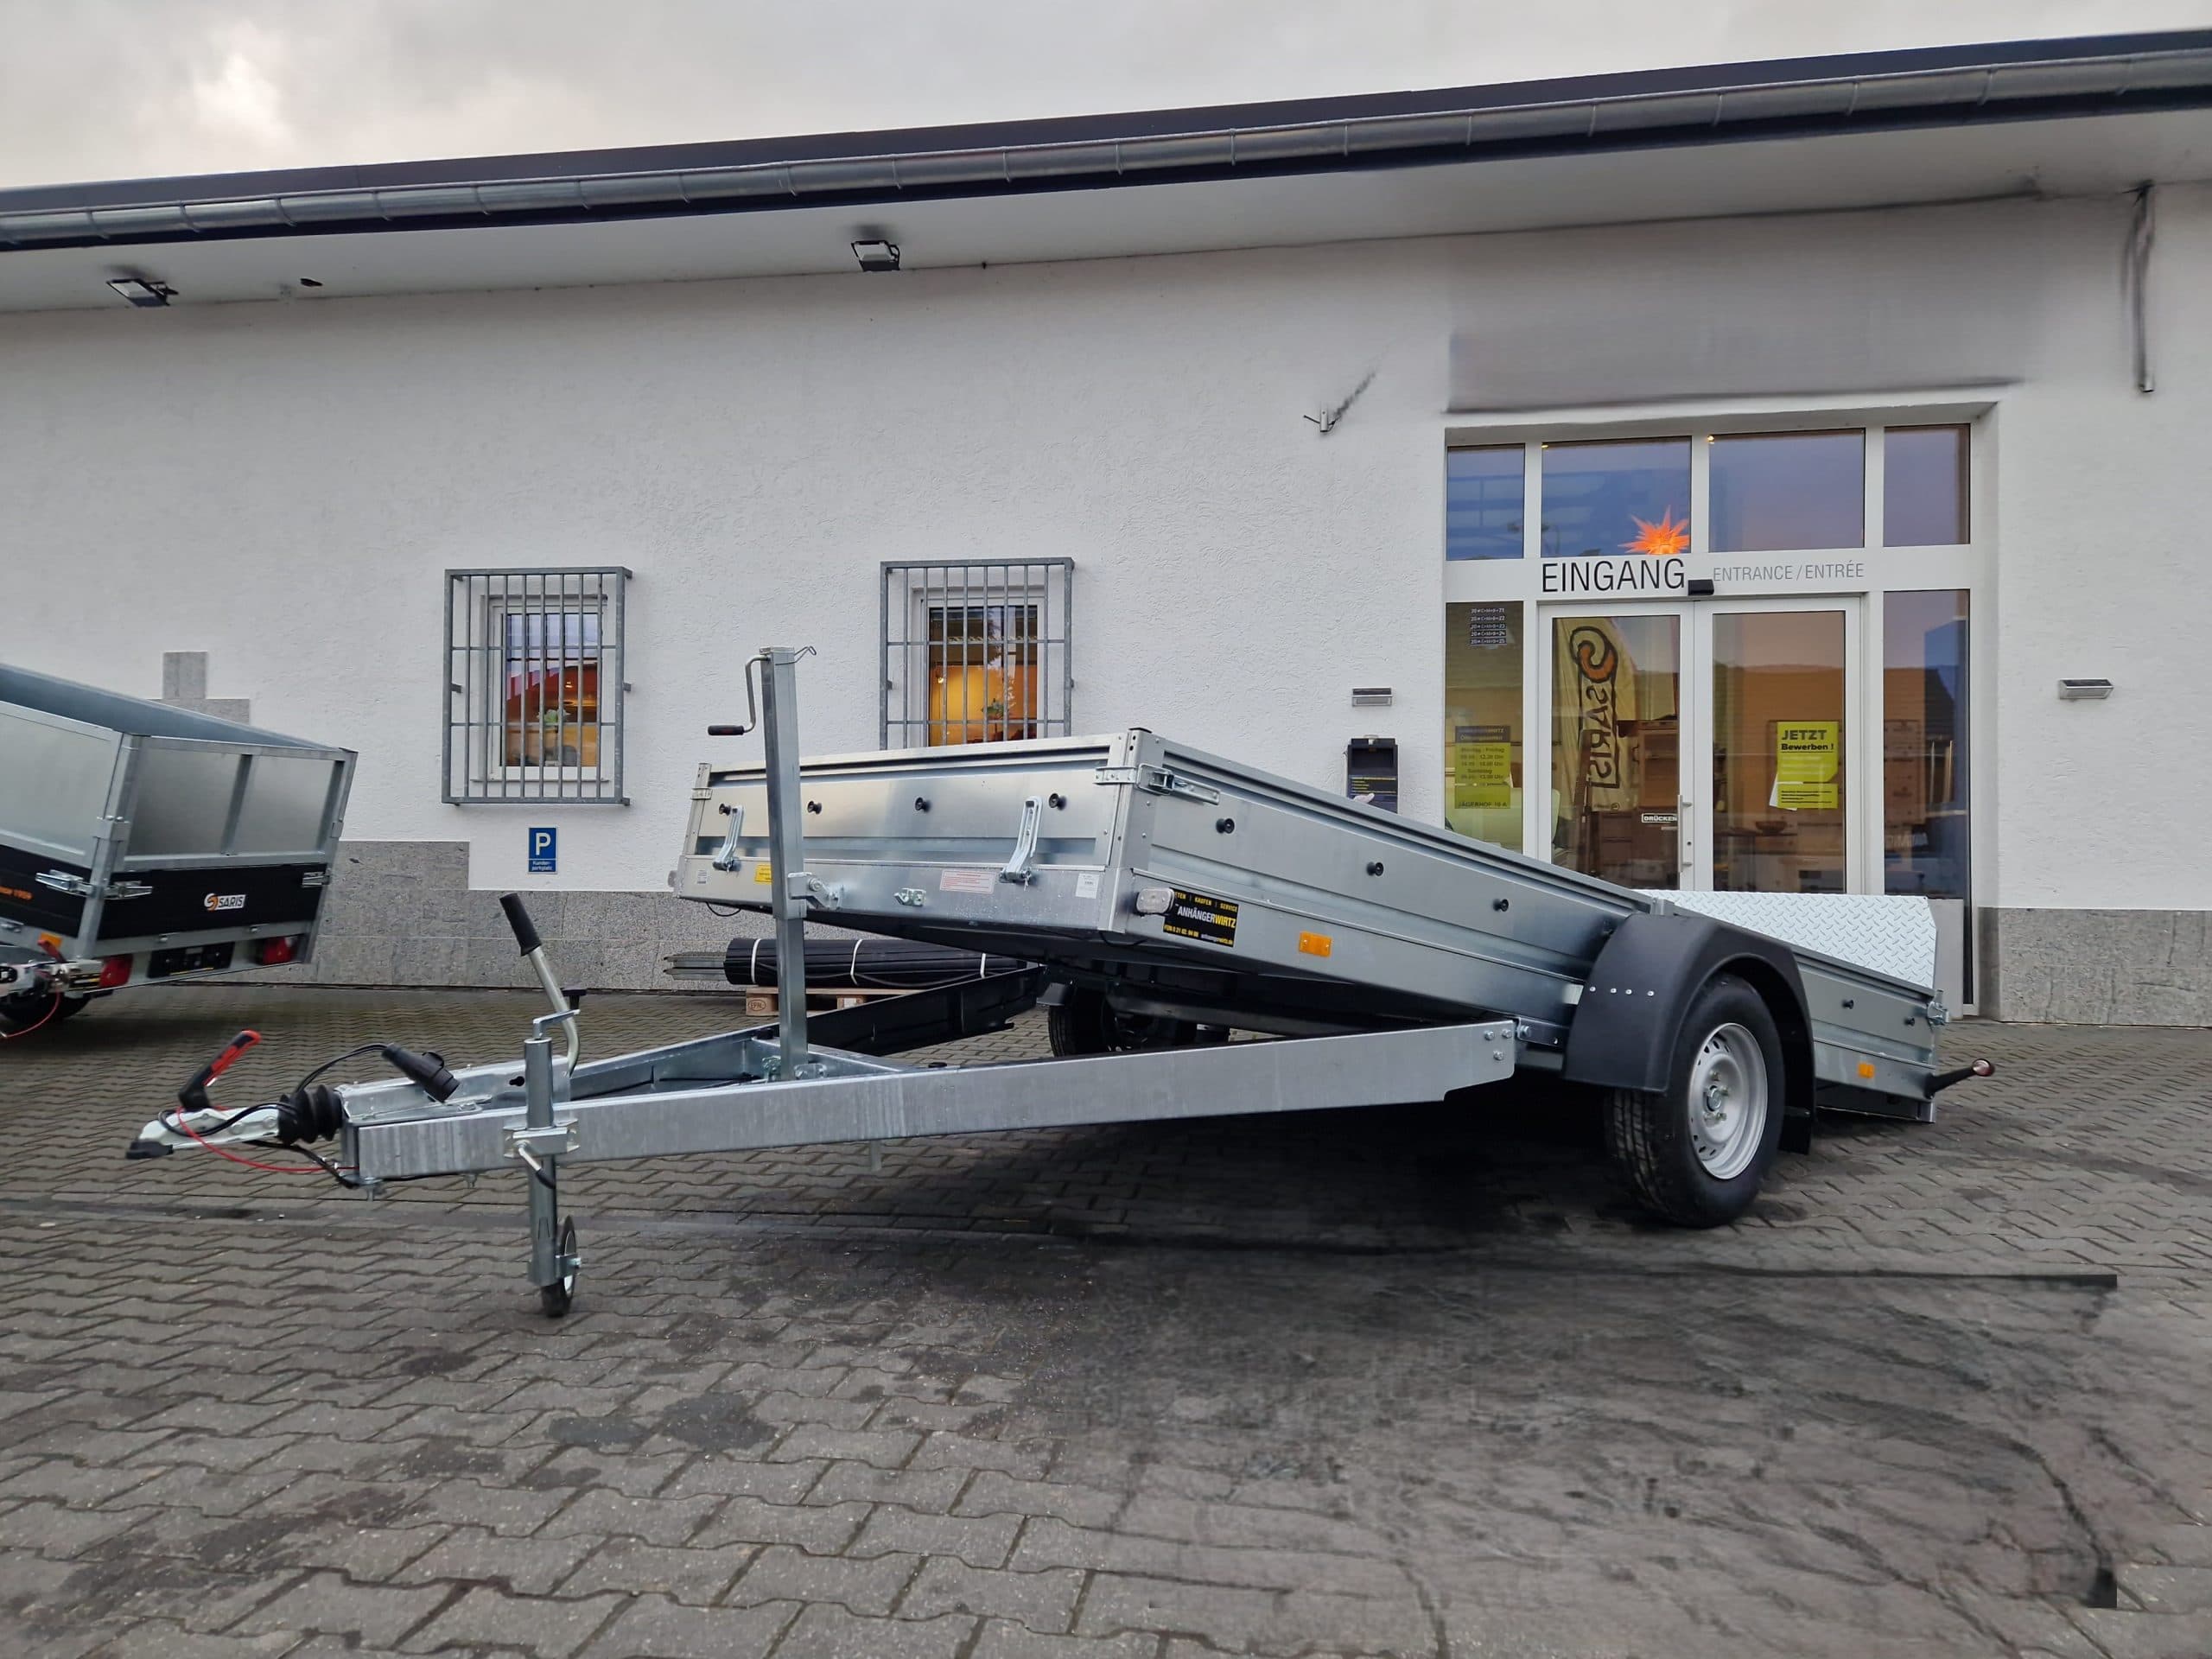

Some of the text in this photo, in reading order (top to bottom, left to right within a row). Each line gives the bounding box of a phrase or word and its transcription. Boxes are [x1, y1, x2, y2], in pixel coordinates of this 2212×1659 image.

[1542, 558, 1685, 593] EINGANG
[1713, 565, 1793, 582] ENTRANCE
[1805, 560, 1865, 580] ENTRÉE
[1782, 729, 1827, 741] JETZT
[536, 832, 551, 855] P
[219, 896, 244, 907] SARIS
[1177, 906, 1236, 928] ANHÄNGERWIRTZ
